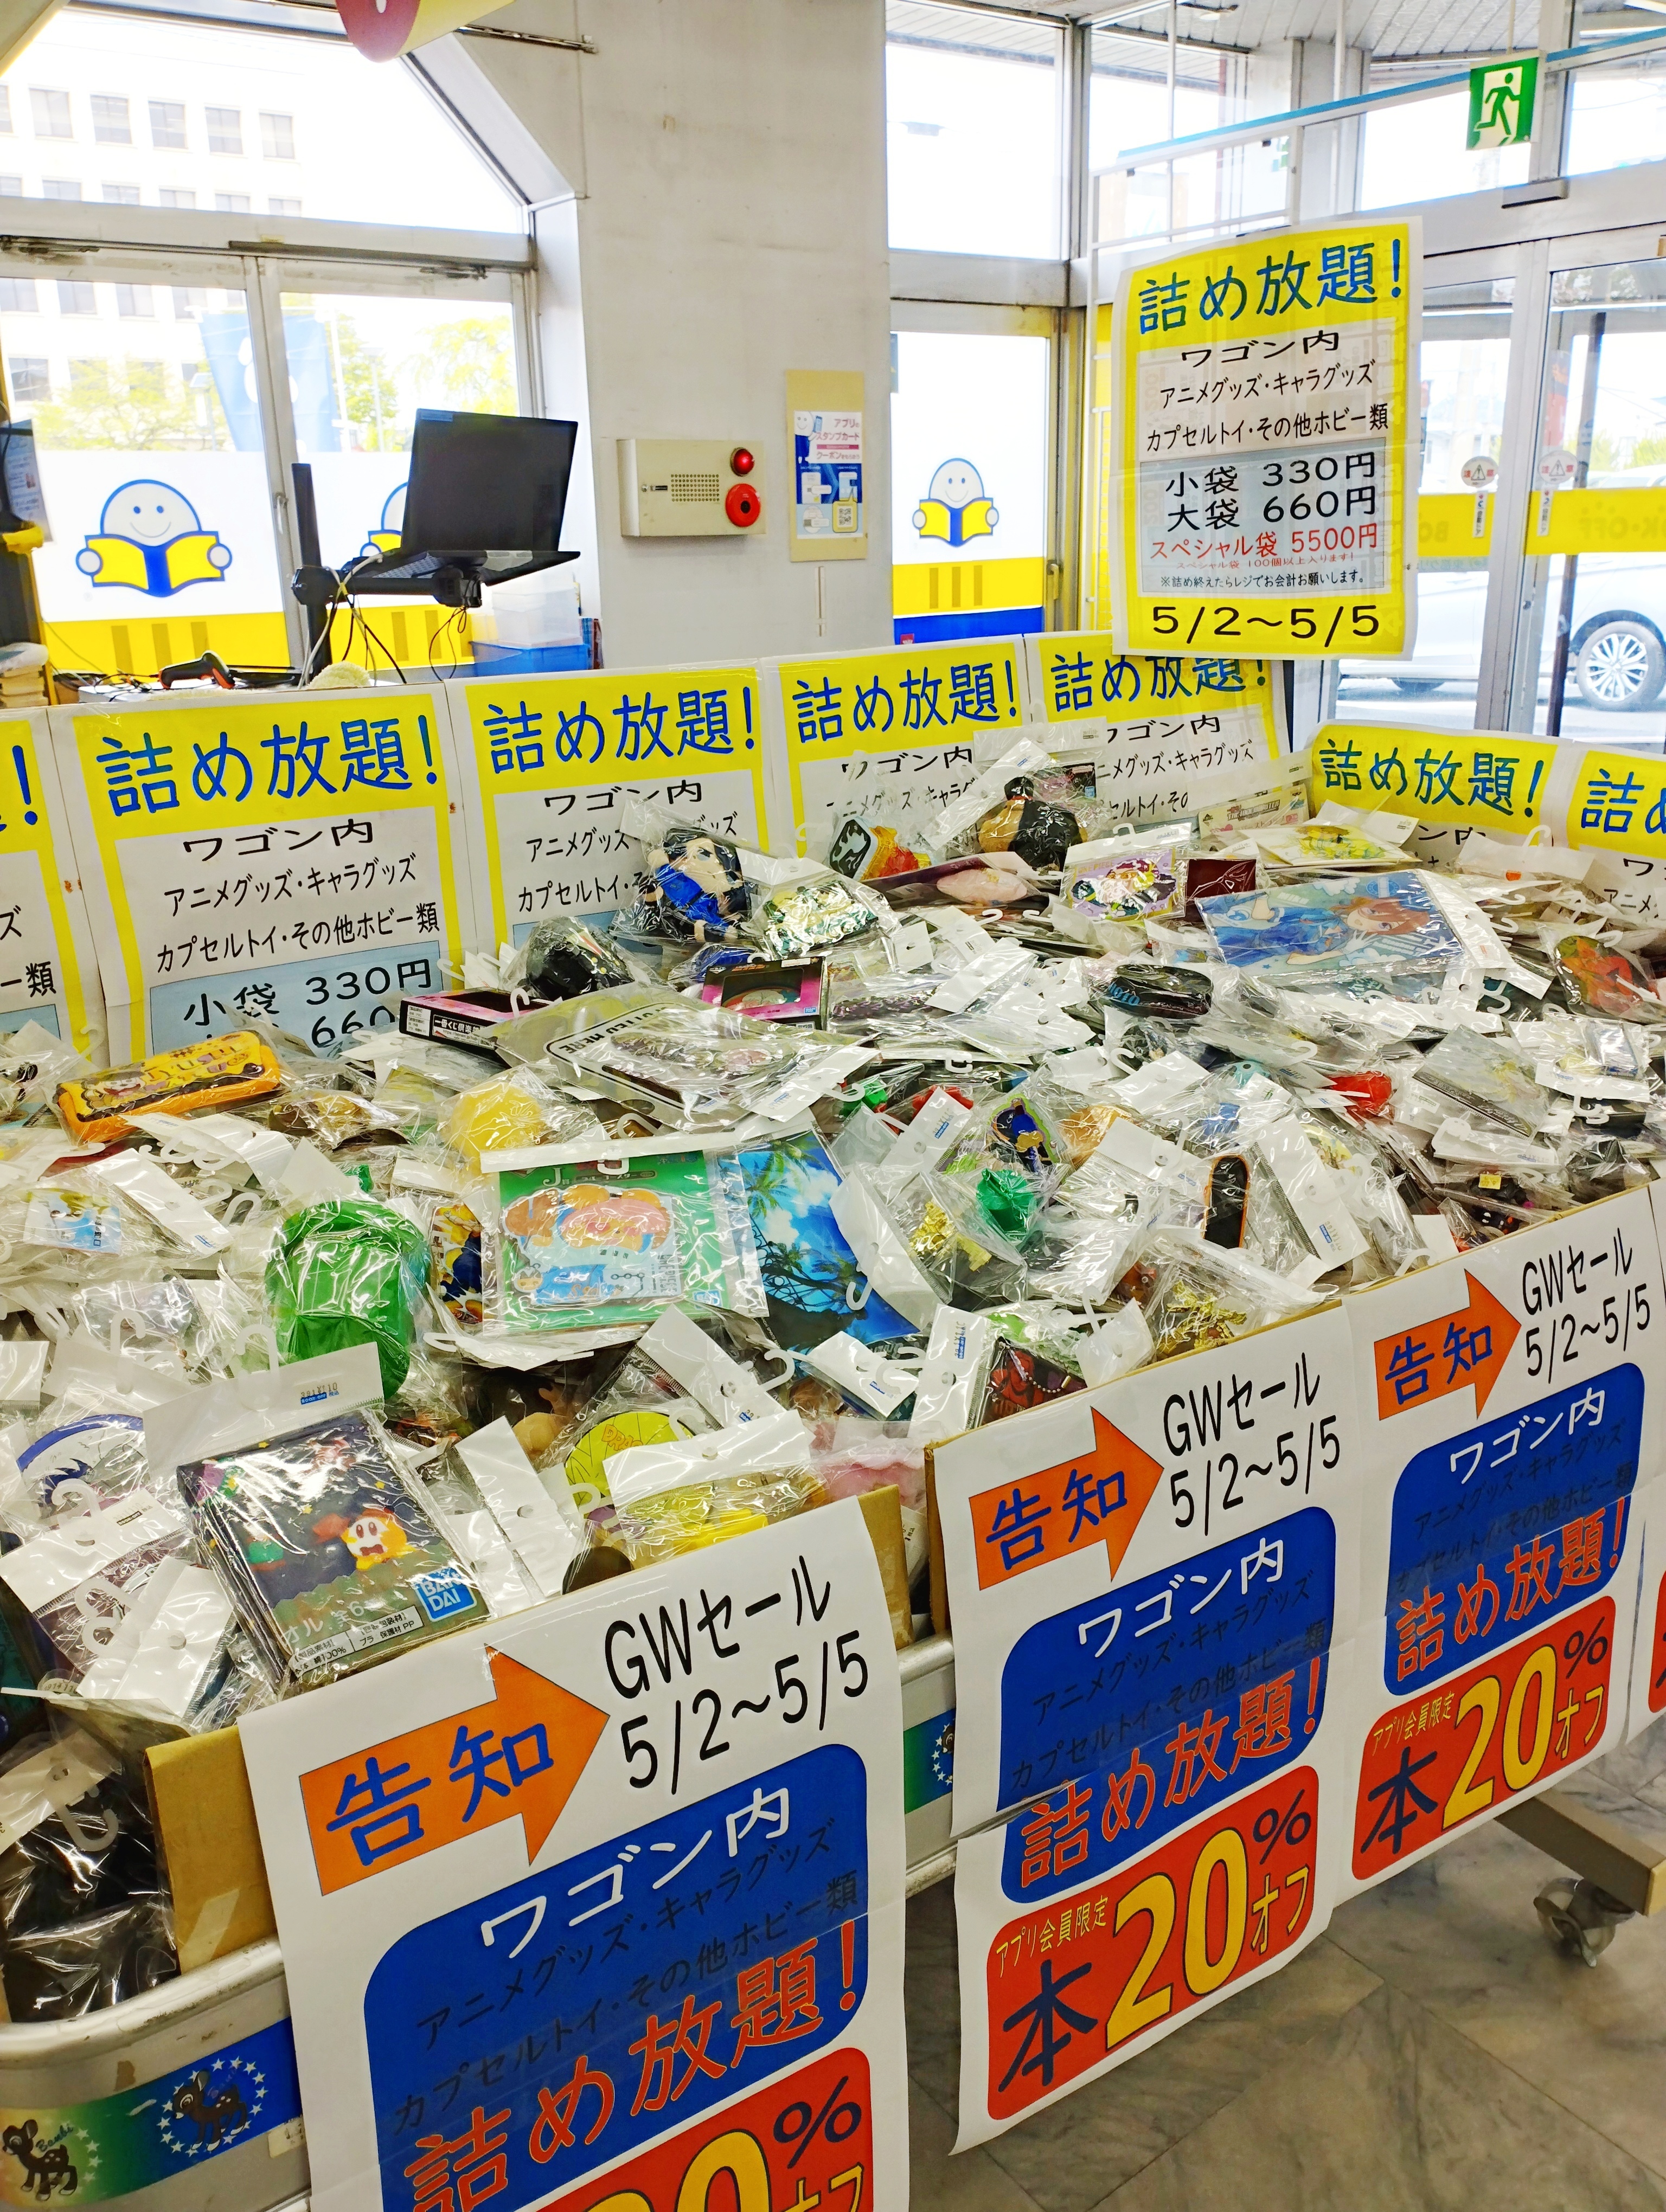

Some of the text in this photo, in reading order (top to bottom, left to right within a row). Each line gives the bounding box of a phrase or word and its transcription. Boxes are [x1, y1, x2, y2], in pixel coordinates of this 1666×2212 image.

[1138, 239, 1401, 334] 詰め放題!
[1160, 361, 1376, 409] アニメグッズ・キャラグッズ
[1182, 331, 1339, 368] ワゴン内
[1147, 403, 1389, 451] カプセルトイ・その他ホビー類
[1165, 452, 1375, 497] 小袋 330円
[1167, 486, 1375, 532] 大袋 660円
[1150, 523, 1377, 560] スペシャル袋 5500円
[1176, 560, 1240, 570] スペシャル袋
[484, 686, 754, 774] 詰め放題!
[792, 660, 1017, 743] 詰め放題!
[97, 715, 438, 817] 詰め放題!
[1095, 739, 1253, 780] ニメグッズ・キャラグッズ
[1319, 740, 1544, 818] 詰め放題!
[183, 819, 374, 862] ワゴン内
[164, 852, 416, 917] アニメグッズ・キャラグッズ
[157, 901, 440, 974] カプセルトイ・その他ホビー類
[305, 958, 431, 1006] 330円
[1522, 1227, 1632, 1315] GWセール
[1163, 1352, 1320, 1456] GWセール
[1385, 1321, 1492, 1405] 告知
[1450, 1387, 1605, 1484] ワゴン内
[985, 1468, 1127, 1571] 告知
[604, 1555, 830, 1699] GWセール
[1078, 1538, 1283, 1658] ワゴン内
[1397, 1496, 1625, 1682] 詰め放題!
[1373, 1690, 1456, 1756] アプリ会員限定
[326, 1721, 554, 1867] 告知
[1021, 1657, 1321, 1889] 詰め放題!
[480, 1787, 790, 1959] ワゴン内
[416, 1817, 837, 2052] アニメグッズ・キャラグッズ
[996, 1895, 1108, 1979] アプリ会員限定
[393, 1868, 858, 2136] カプセルトイ・その他ホビー類
[403, 1919, 856, 2212] 詰め放題!
